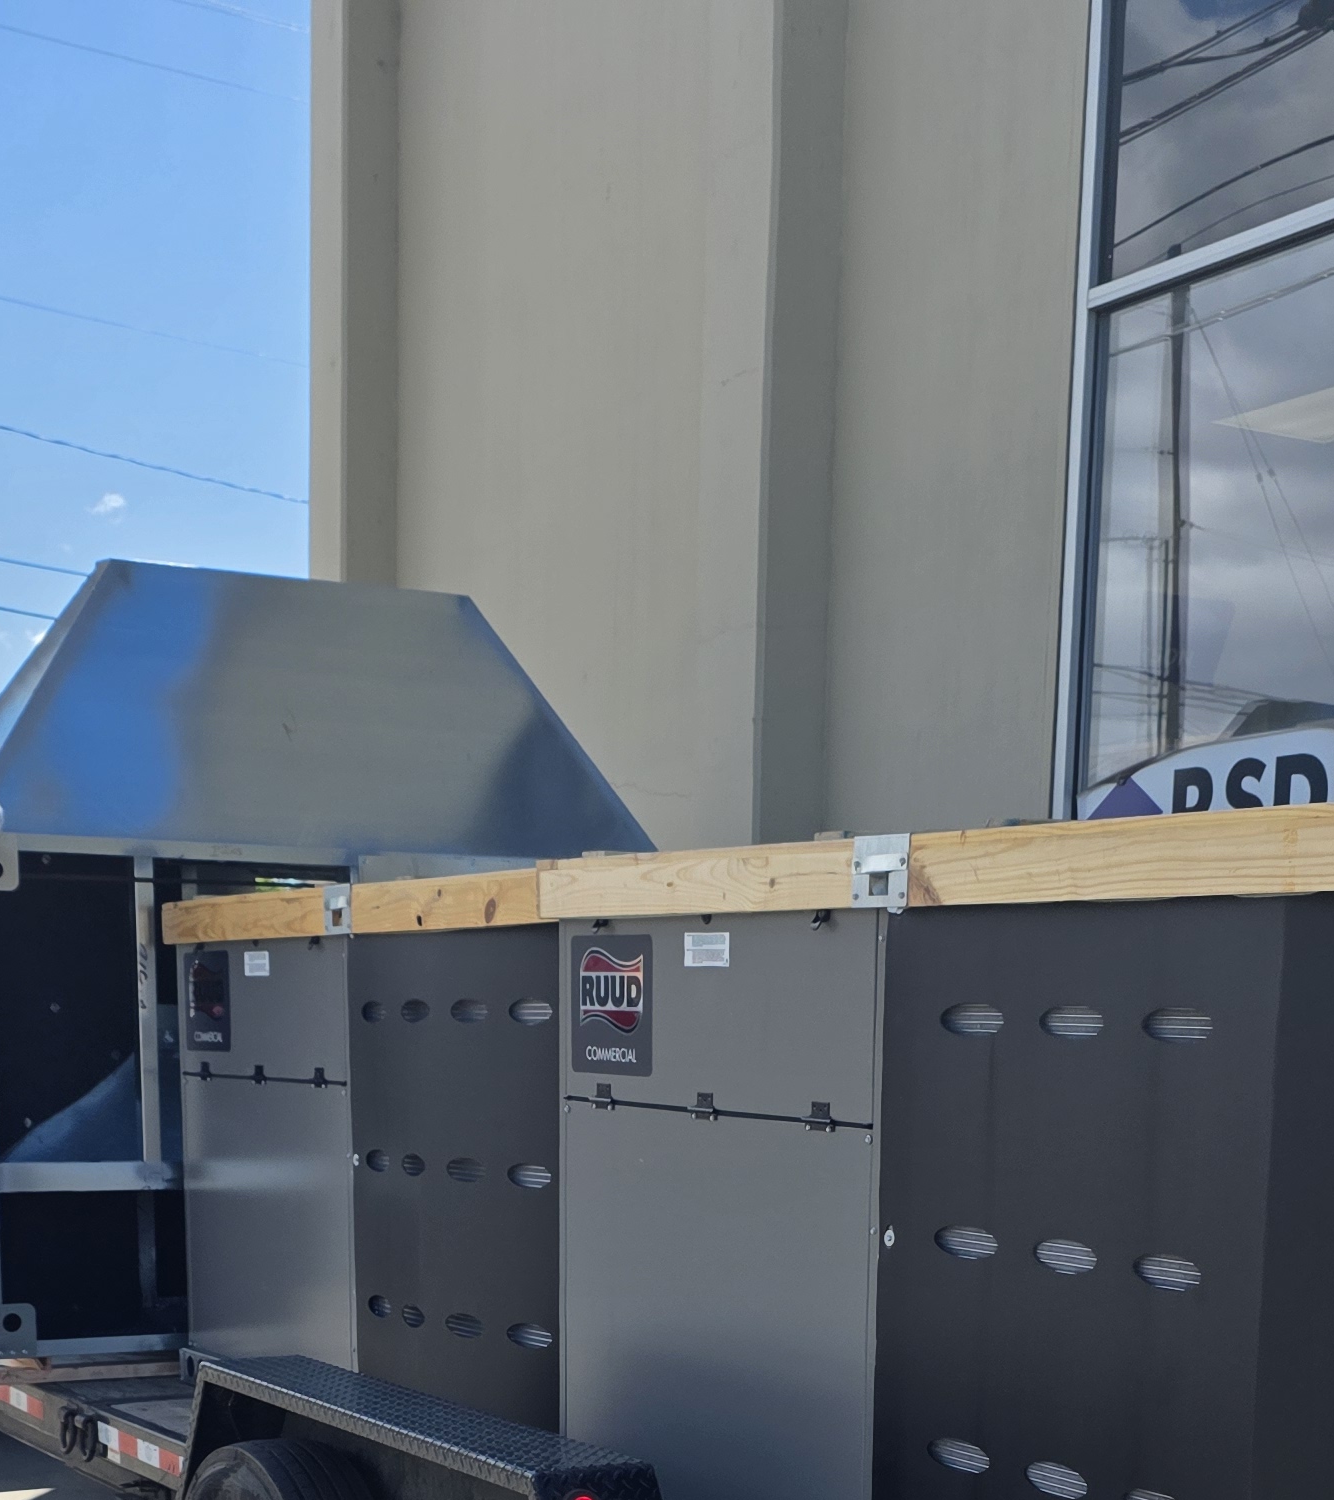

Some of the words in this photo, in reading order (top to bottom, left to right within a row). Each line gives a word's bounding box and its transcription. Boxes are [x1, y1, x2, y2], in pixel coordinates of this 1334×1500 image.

[1171, 752, 1330, 811] RSD
[581, 975, 642, 1008] RUUD
[586, 1046, 637, 1063] COMMERCIAL
